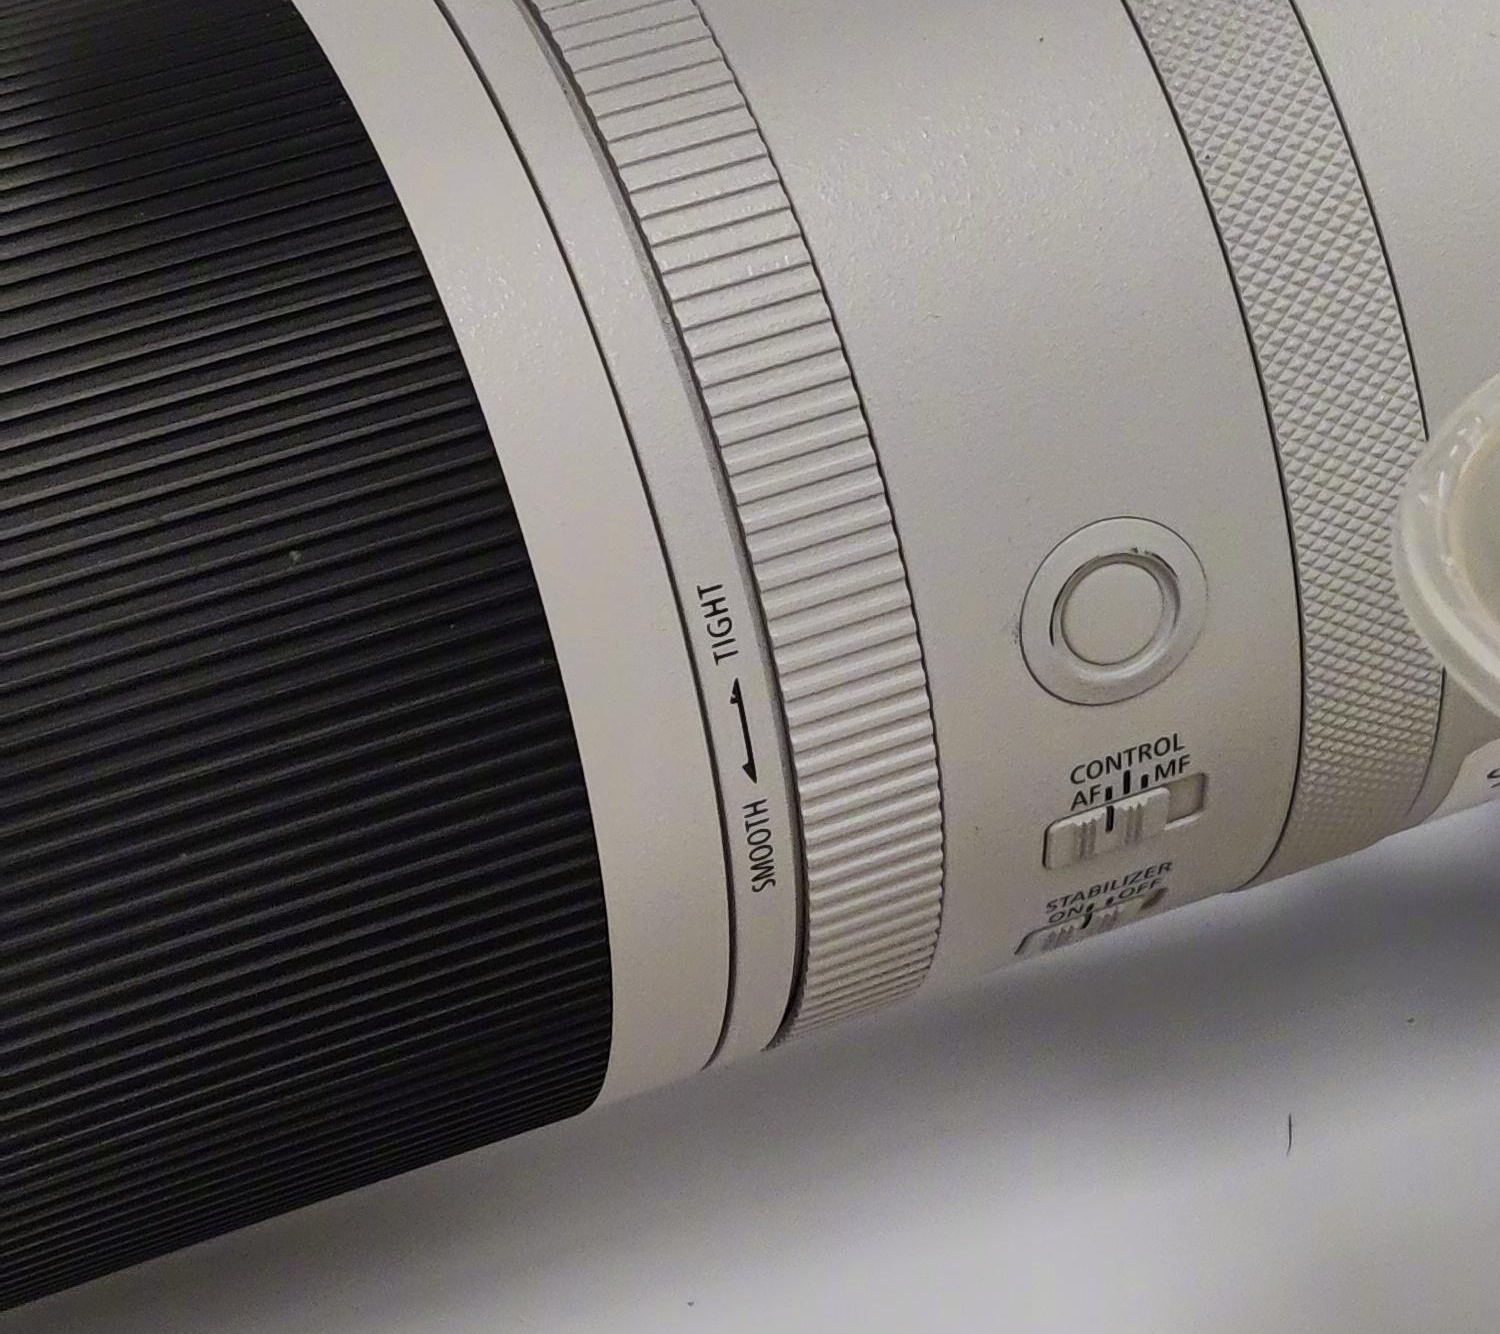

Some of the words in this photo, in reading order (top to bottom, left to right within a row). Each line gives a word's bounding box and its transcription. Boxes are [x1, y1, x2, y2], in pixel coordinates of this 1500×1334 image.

[696, 583, 739, 666] TIGHT
[1070, 733, 1186, 785] CONTROL
[1070, 784, 1101, 811] AF
[1154, 754, 1191, 782] MF
[742, 798, 776, 893] SMOOTH
[1046, 861, 1173, 913] STABILIZER
[1048, 904, 1084, 924] ON
[1118, 878, 1164, 900] OFF
